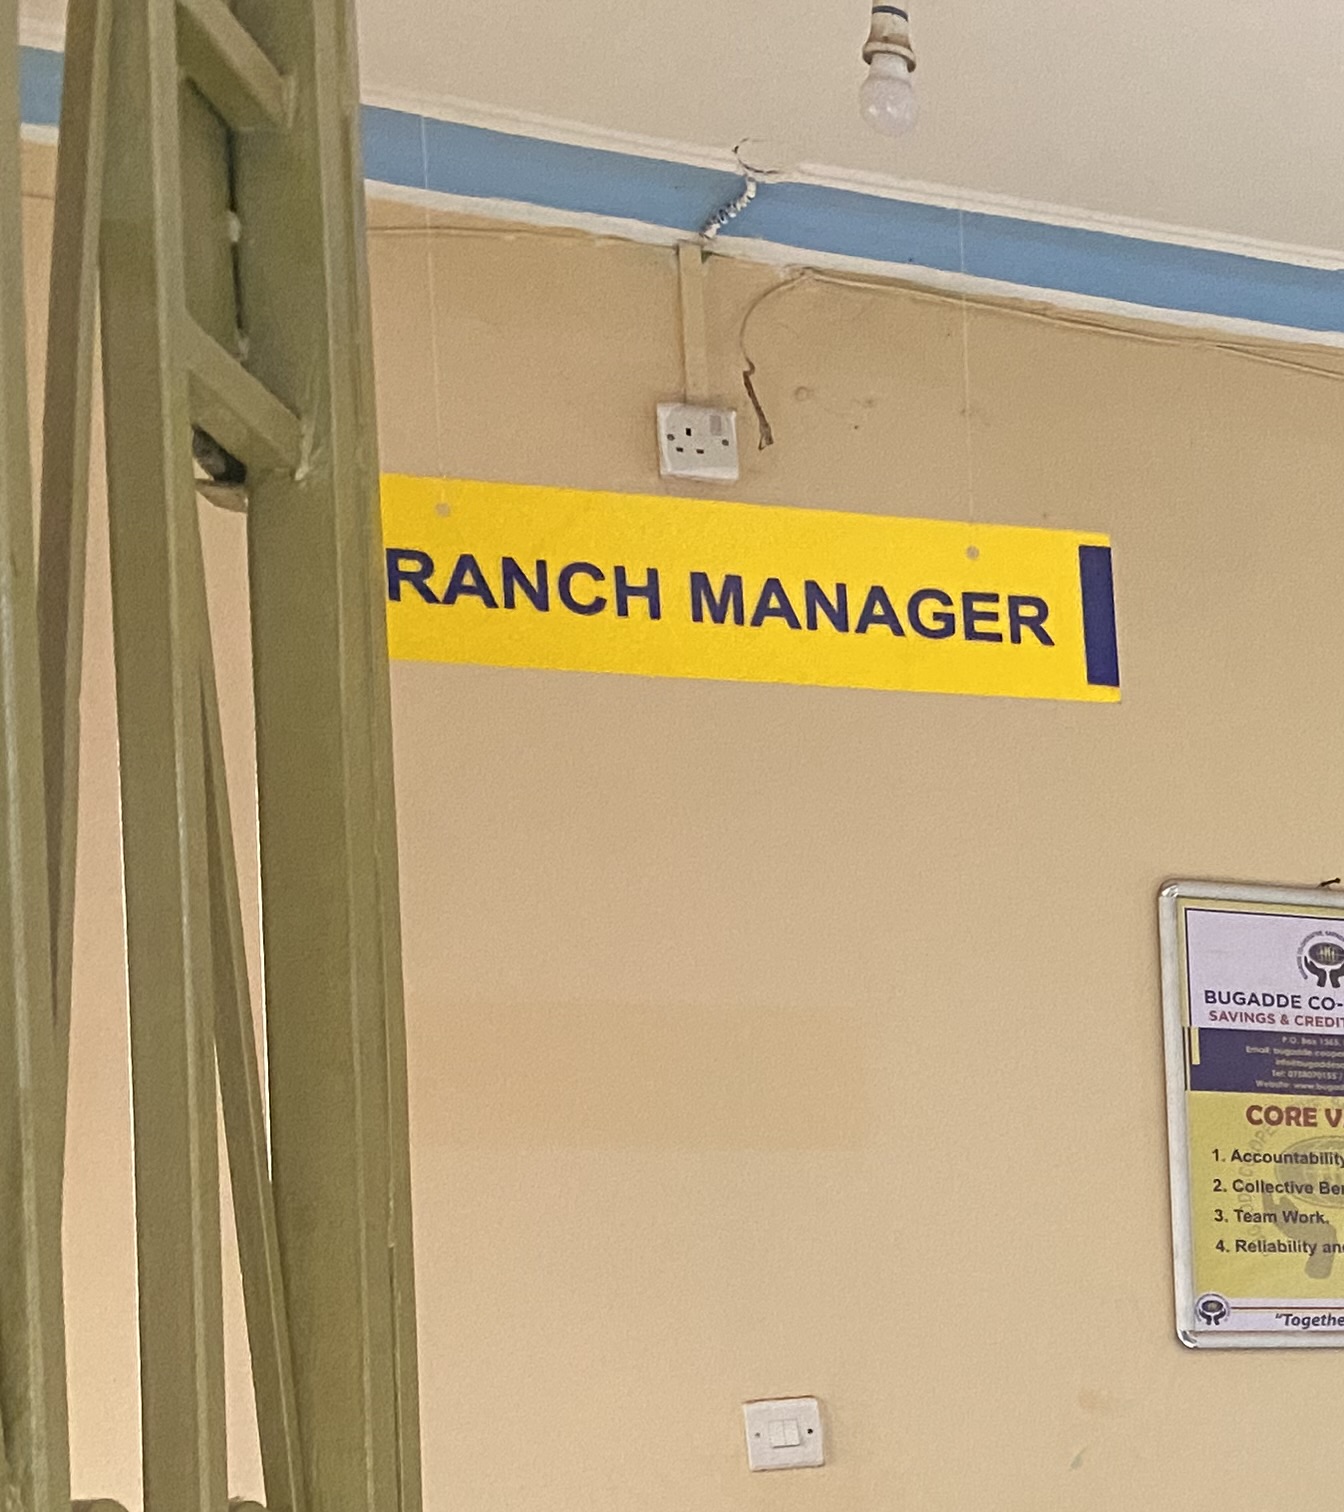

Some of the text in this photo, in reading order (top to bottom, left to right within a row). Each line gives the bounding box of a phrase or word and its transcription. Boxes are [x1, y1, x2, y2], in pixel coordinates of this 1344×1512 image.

[385, 547, 1055, 646] RANCH MANAGER
[1204, 990, 1302, 1009] BUGADDE
[1208, 1010, 1276, 1025] SAVINGS
[1280, 1014, 1290, 1026] &
[1246, 1105, 1318, 1127] CORE
[1212, 1149, 1226, 1163] 1.
[1213, 1179, 1227, 1193] 2.
[1232, 1179, 1314, 1195] Collective
[1214, 1209, 1330, 1226] 3. Team Work.
[1215, 1239, 1230, 1253] 4.
[1235, 1239, 1317, 1258] Reliability
